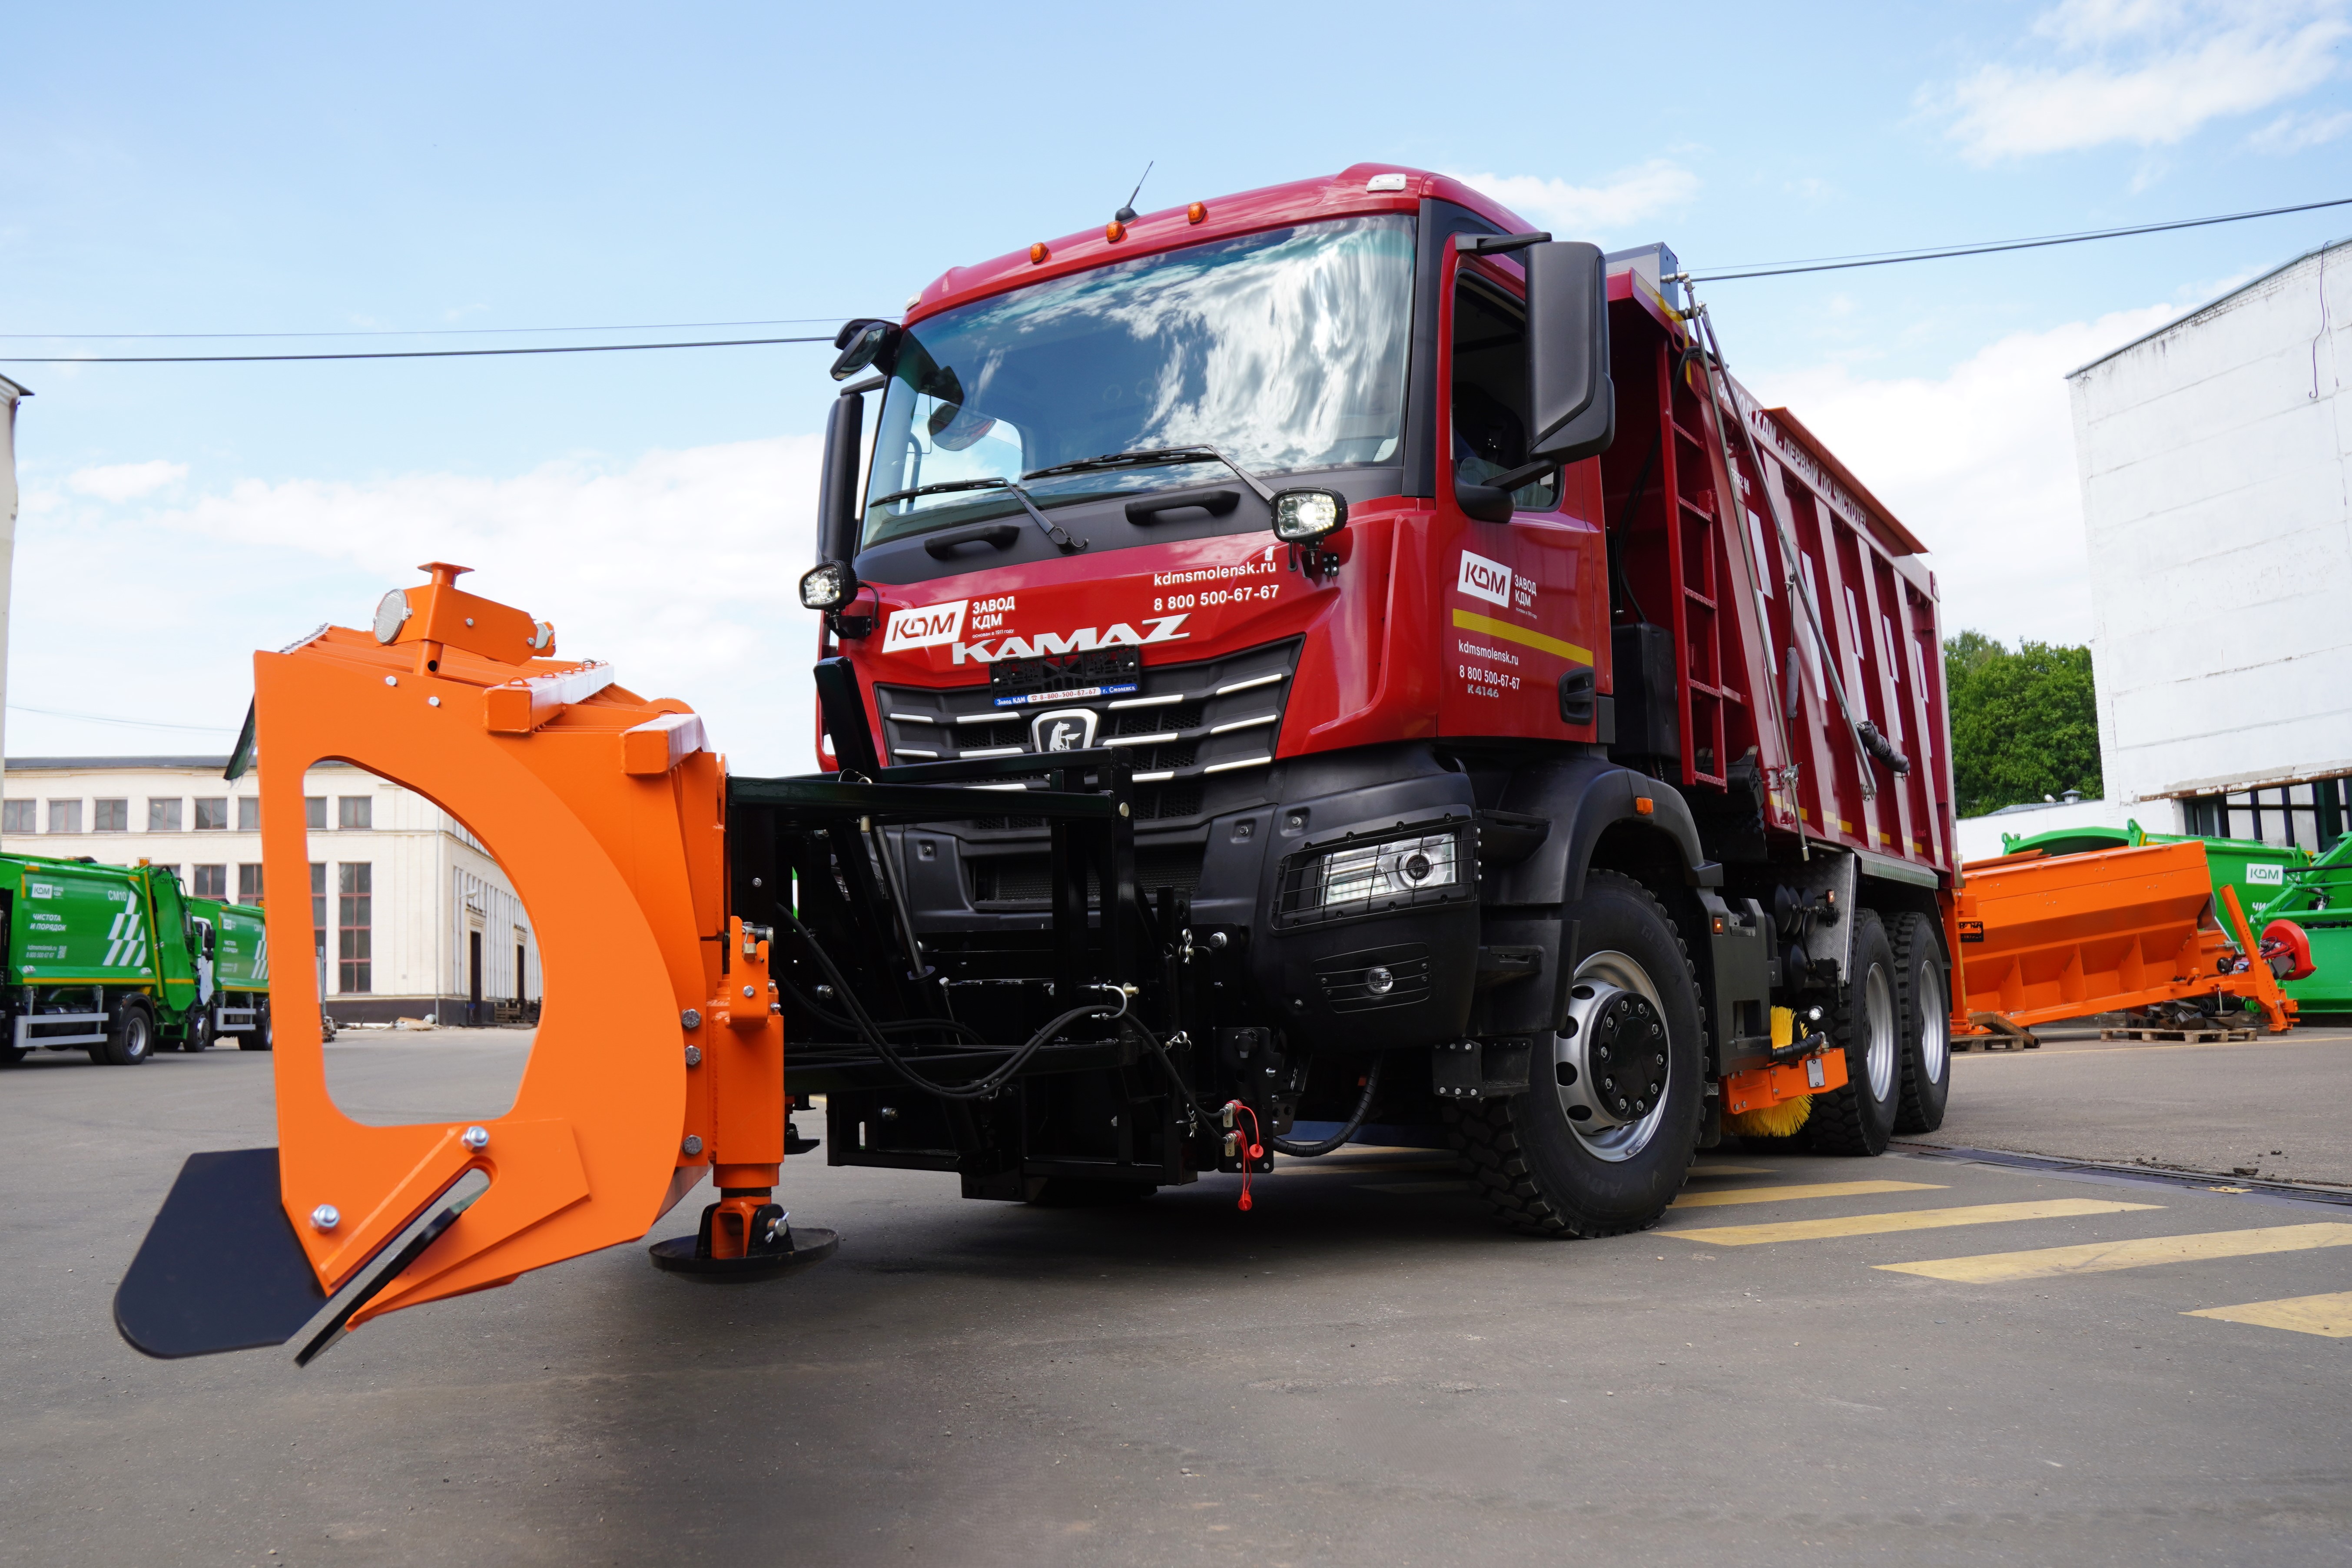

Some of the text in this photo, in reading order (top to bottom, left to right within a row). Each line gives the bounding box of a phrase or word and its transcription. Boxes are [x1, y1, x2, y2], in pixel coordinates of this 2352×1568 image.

[1755, 408, 1776, 446] КДМ
[1784, 436, 1818, 486] ПЕРВЫЙ
[1821, 471, 1831, 497] ПО
[1834, 484, 1866, 530] ЧИСТОТЕ!
[1154, 561, 1276, 586] kdmsmolensk.ru
[1465, 561, 1506, 597] KDM
[1515, 574, 1536, 596] ЗАВОД
[972, 596, 1015, 614] ЗАВОД
[1154, 584, 1279, 611] 8 800 500-67-67
[1515, 589, 1531, 607] КДМ
[892, 611, 956, 641] KDM
[972, 613, 1002, 630] КДМ
[952, 613, 1191, 665] KAMAZ
[1459, 639, 1519, 666] kdmsmolensk.ru
[1460, 665, 1520, 690] 8 800 500-67-67
[1040, 689, 1096, 700] 8-800-500-67-67
[1475, 685, 1499, 698] 4146
[2251, 868, 2279, 879] KDM
[34, 887, 50, 895] KDM
[108, 890, 127, 901] СМ10
[33, 913, 61, 922] ЧИСТОТА
[36, 923, 66, 932] ПОРЯДОК
